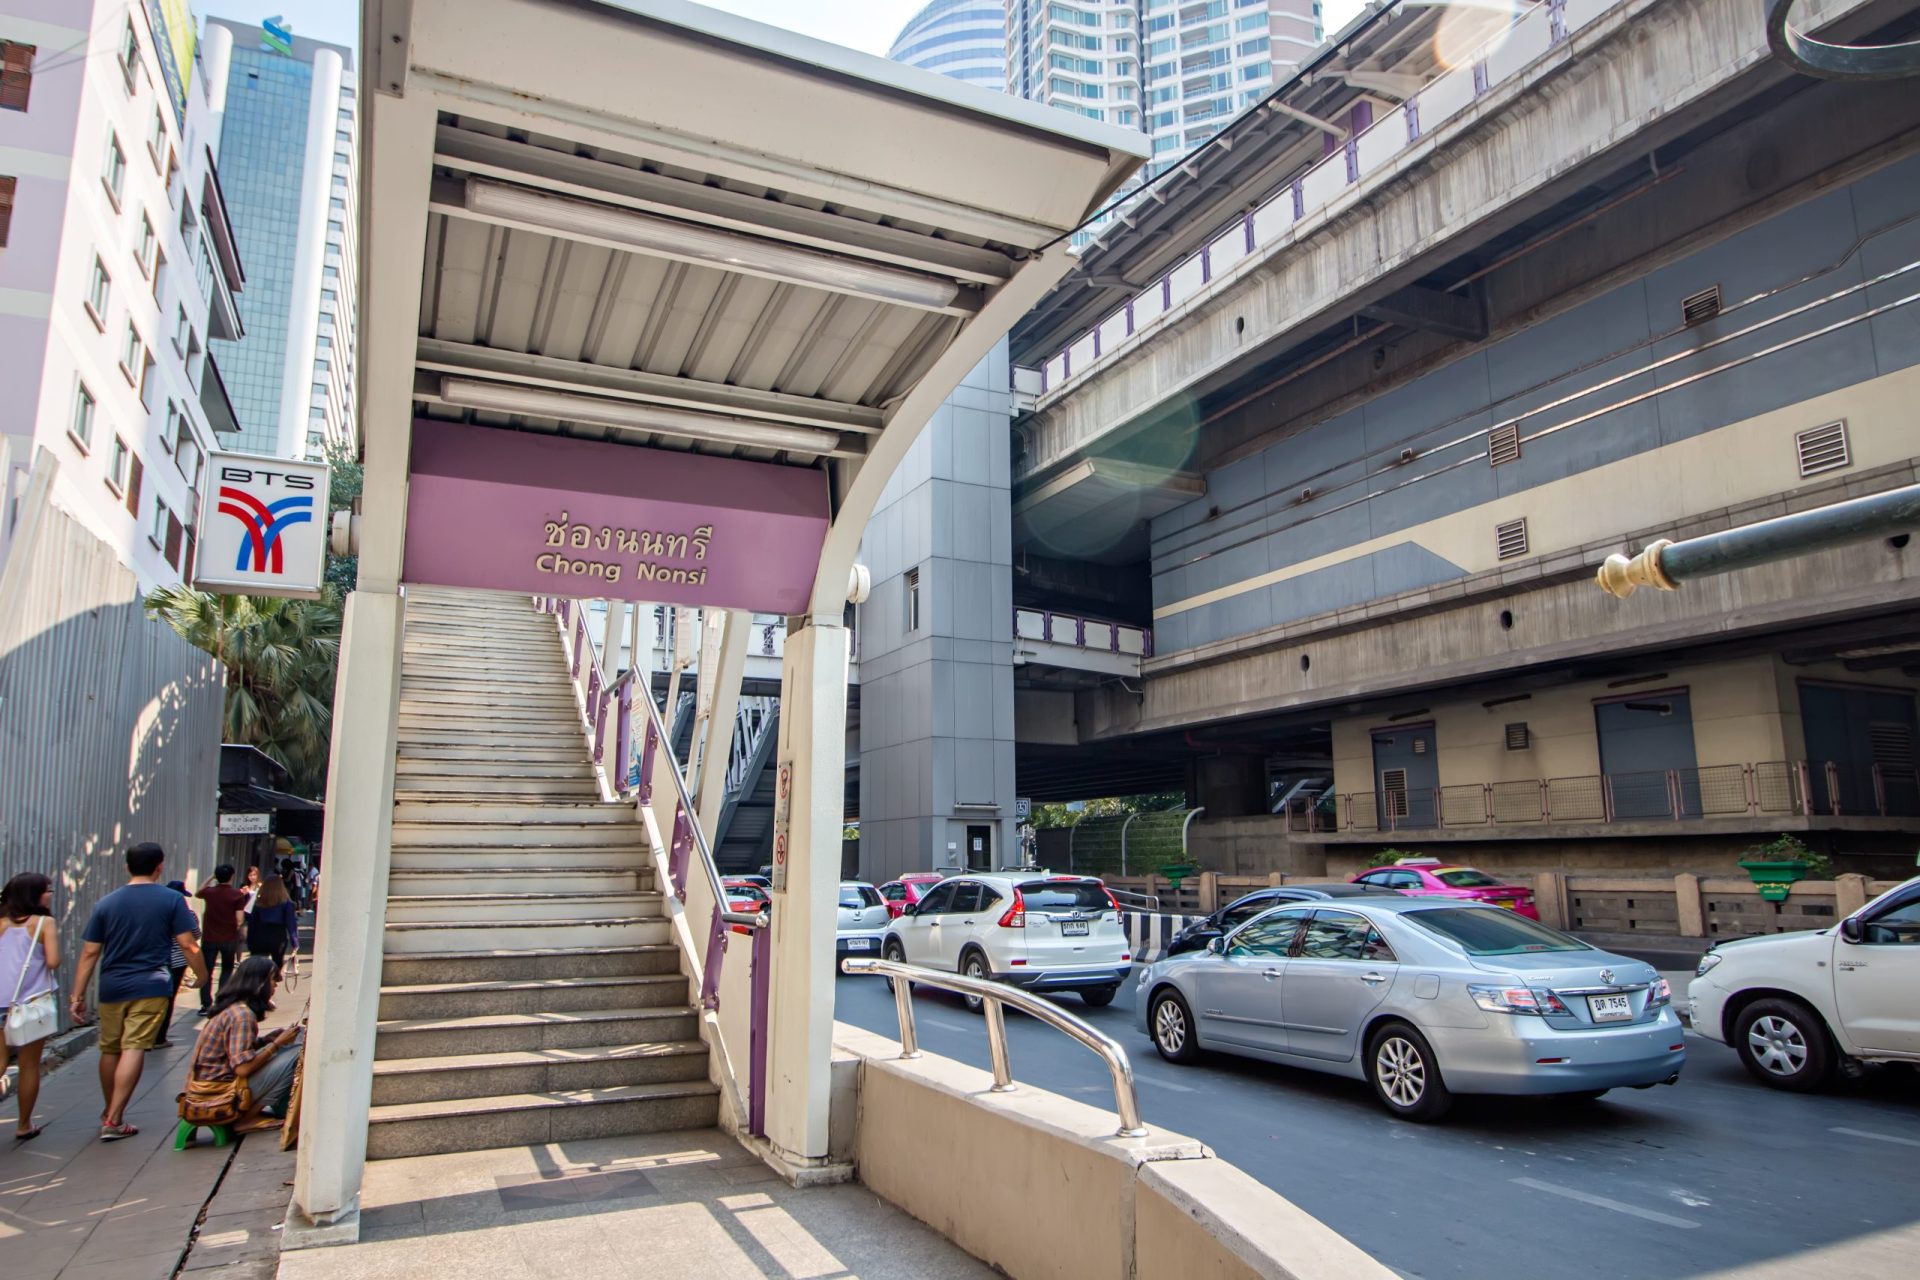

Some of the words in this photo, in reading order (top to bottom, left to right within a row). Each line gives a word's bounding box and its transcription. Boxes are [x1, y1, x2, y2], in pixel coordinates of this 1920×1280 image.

[221, 467, 314, 490] BTS
[544, 511, 713, 560] ช่องนนทรี
[536, 552, 621, 583] Chong
[637, 561, 708, 585] Nonsi
[1608, 997, 1627, 1010] 7545
